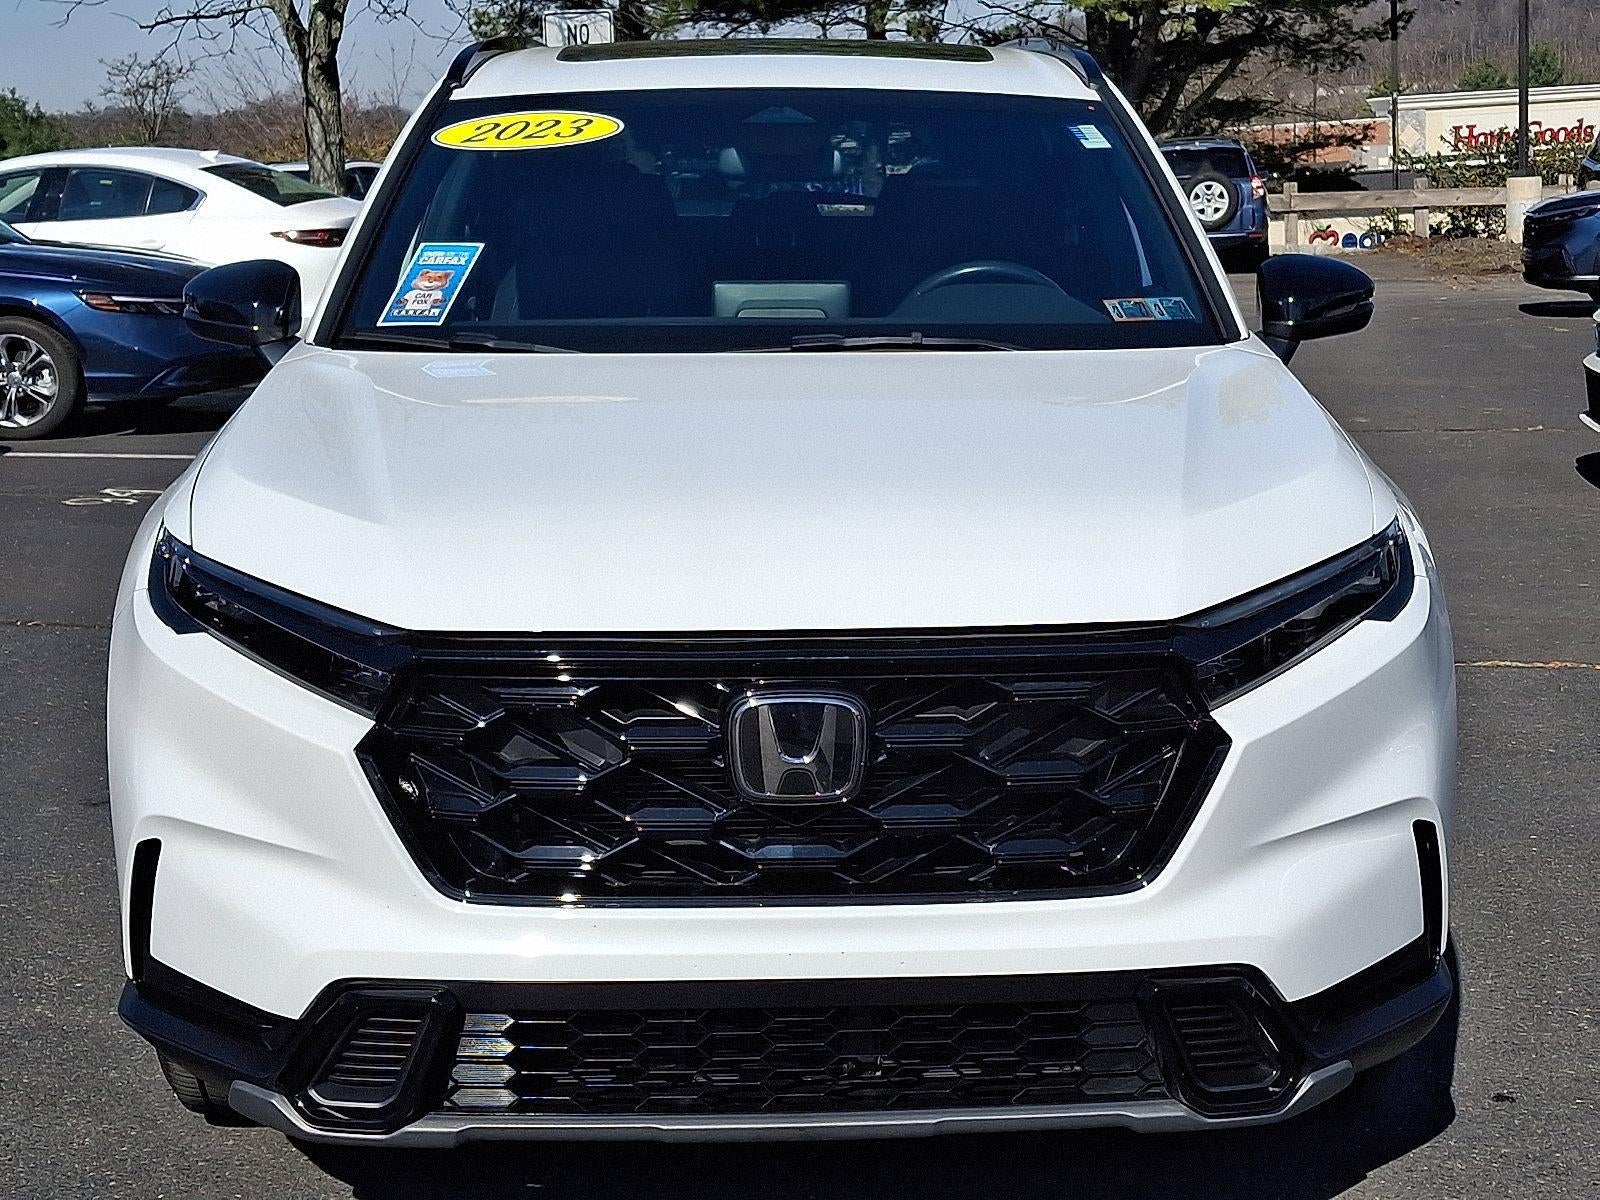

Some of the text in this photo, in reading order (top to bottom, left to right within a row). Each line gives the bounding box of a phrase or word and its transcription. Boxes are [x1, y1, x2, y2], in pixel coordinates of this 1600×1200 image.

[567, 23, 589, 45] NO
[460, 118, 594, 143] 2023
[418, 257, 468, 266] CARFAX
